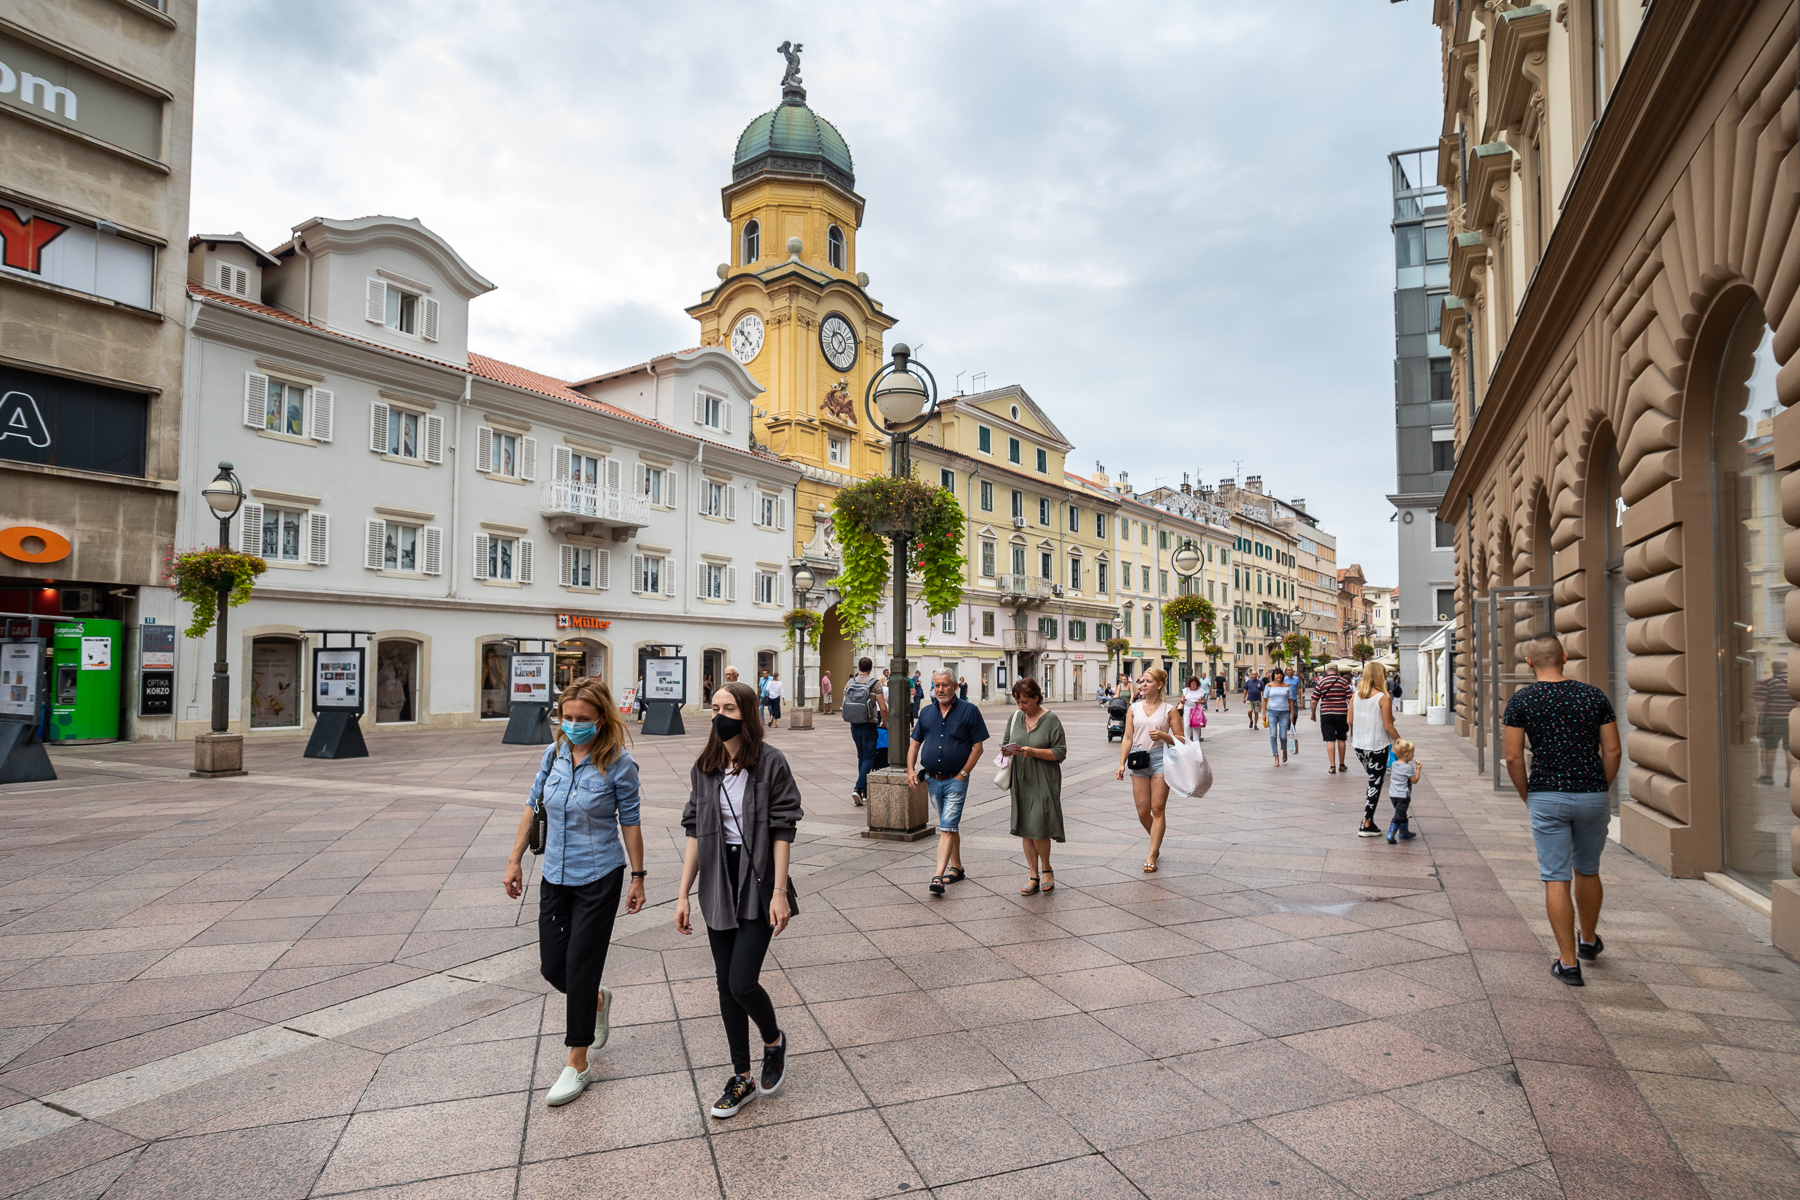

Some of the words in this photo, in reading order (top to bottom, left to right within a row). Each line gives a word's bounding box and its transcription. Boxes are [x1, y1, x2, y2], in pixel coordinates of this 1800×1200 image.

[572, 615, 611, 629] Müller
[0, 626, 30, 636] TSAK
[145, 633, 165, 641] Nad
[147, 679, 169, 687] OPTIKA
[146, 687, 170, 695] KORZO
